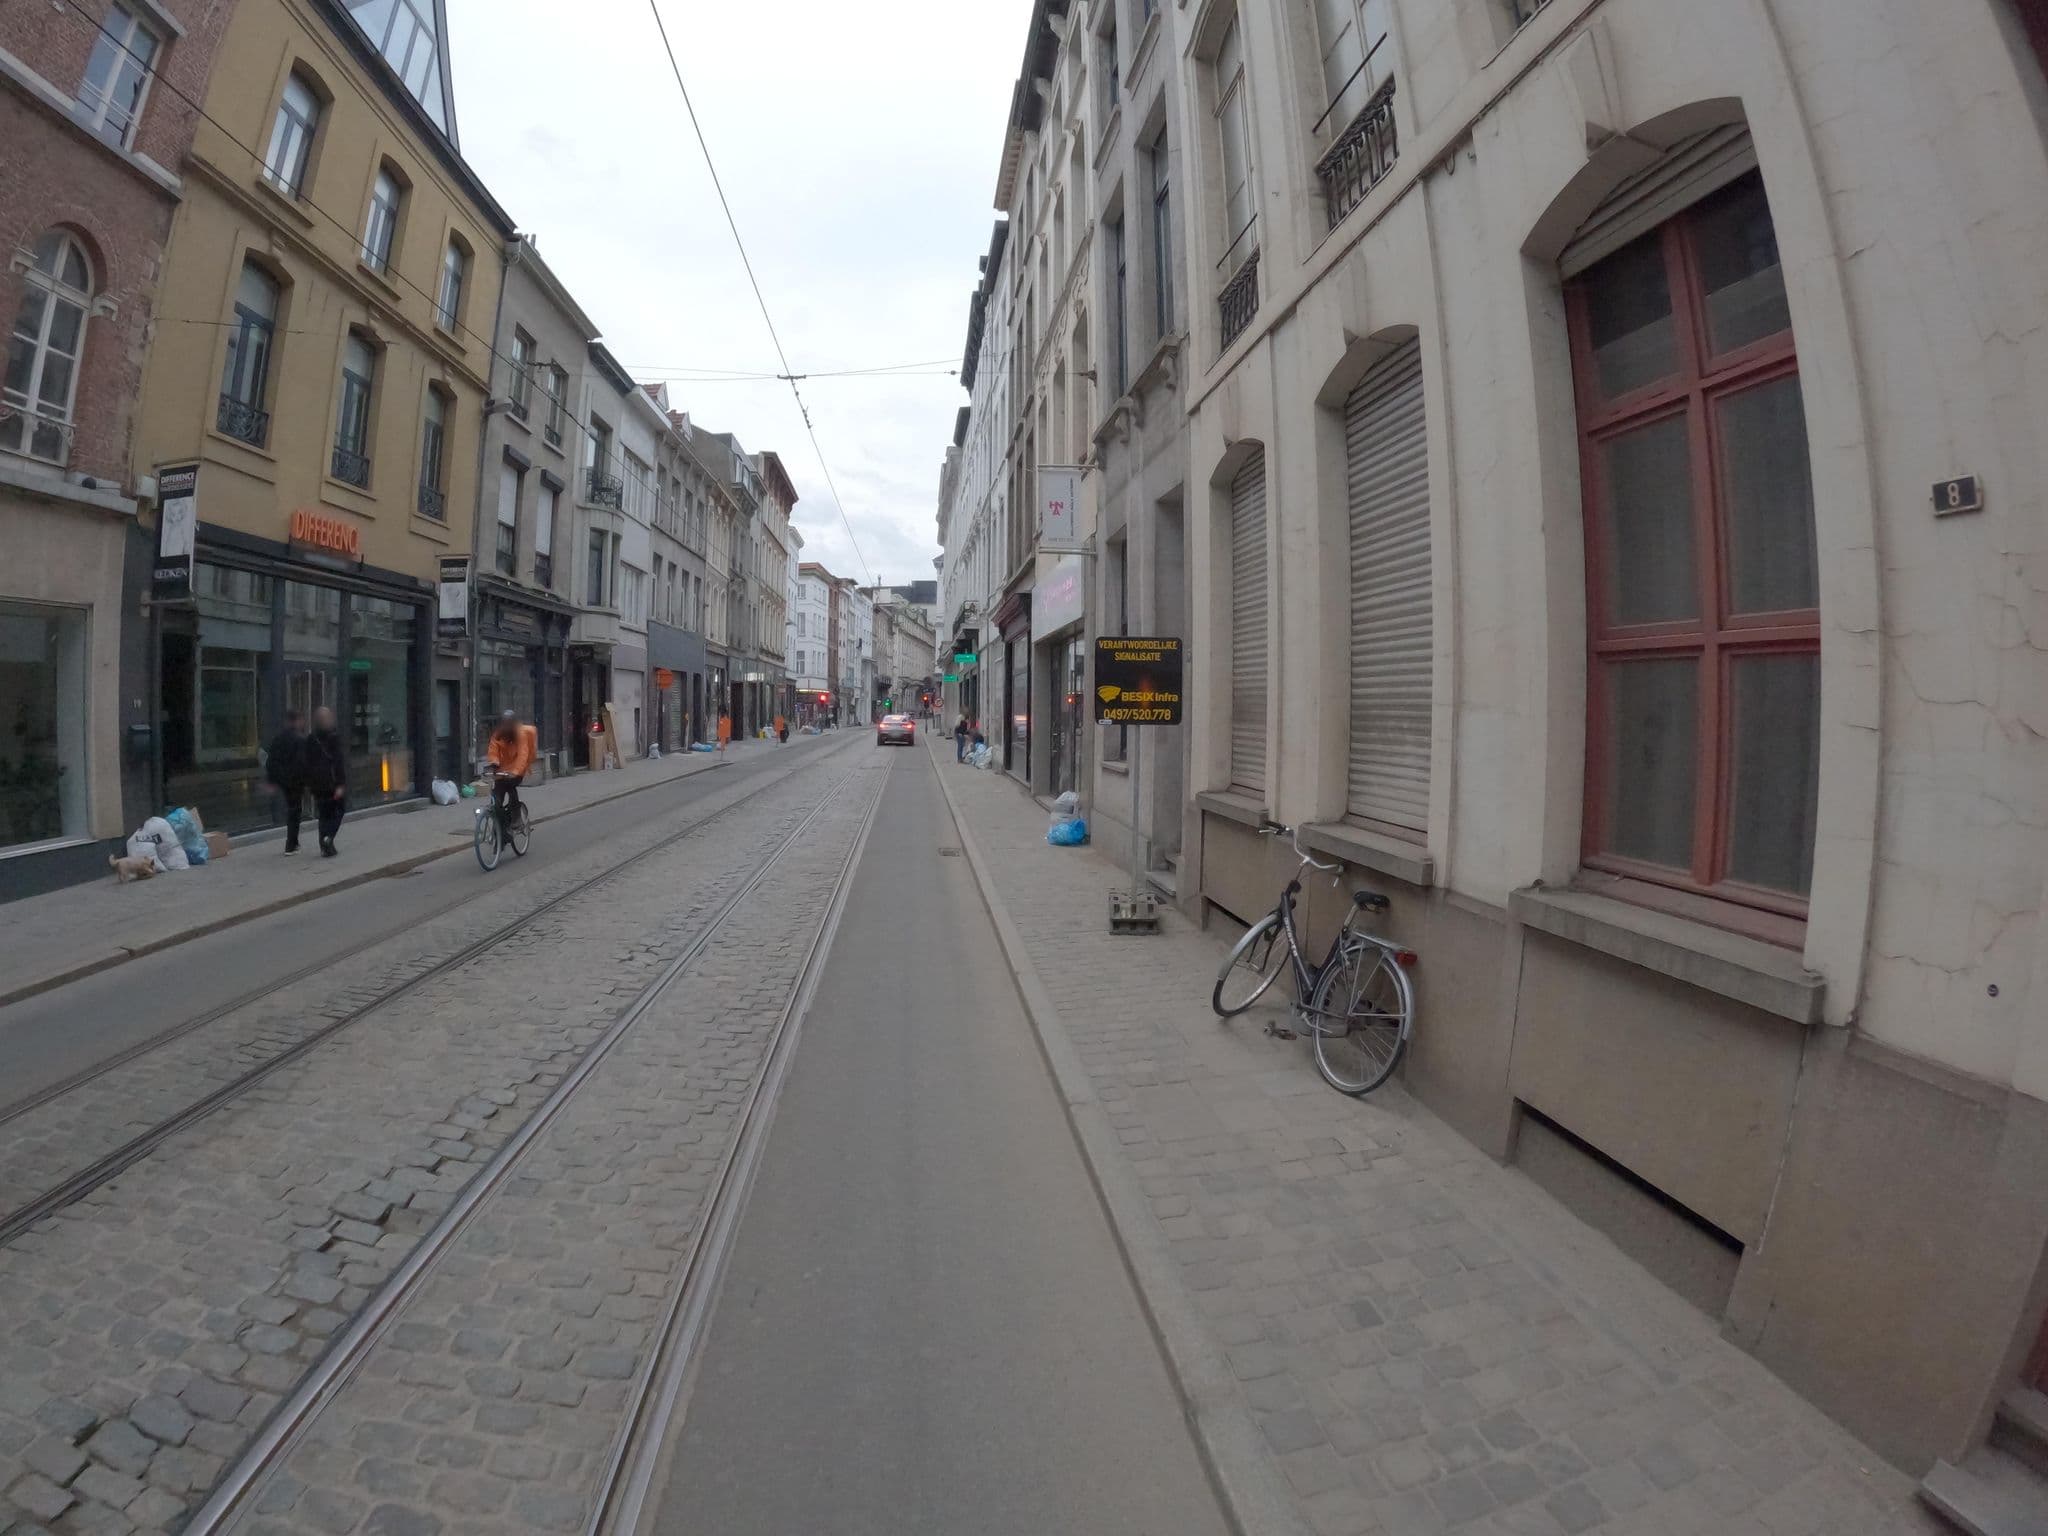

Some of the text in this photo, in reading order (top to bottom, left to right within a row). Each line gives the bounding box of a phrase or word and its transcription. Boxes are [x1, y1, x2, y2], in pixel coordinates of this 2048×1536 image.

[1947, 482, 1960, 506] 8
[1114, 651, 1161, 661] SIGNALISATIE
[1121, 691, 1179, 702] BESIX Infra
[1103, 708, 1172, 720] 0497/520.778
